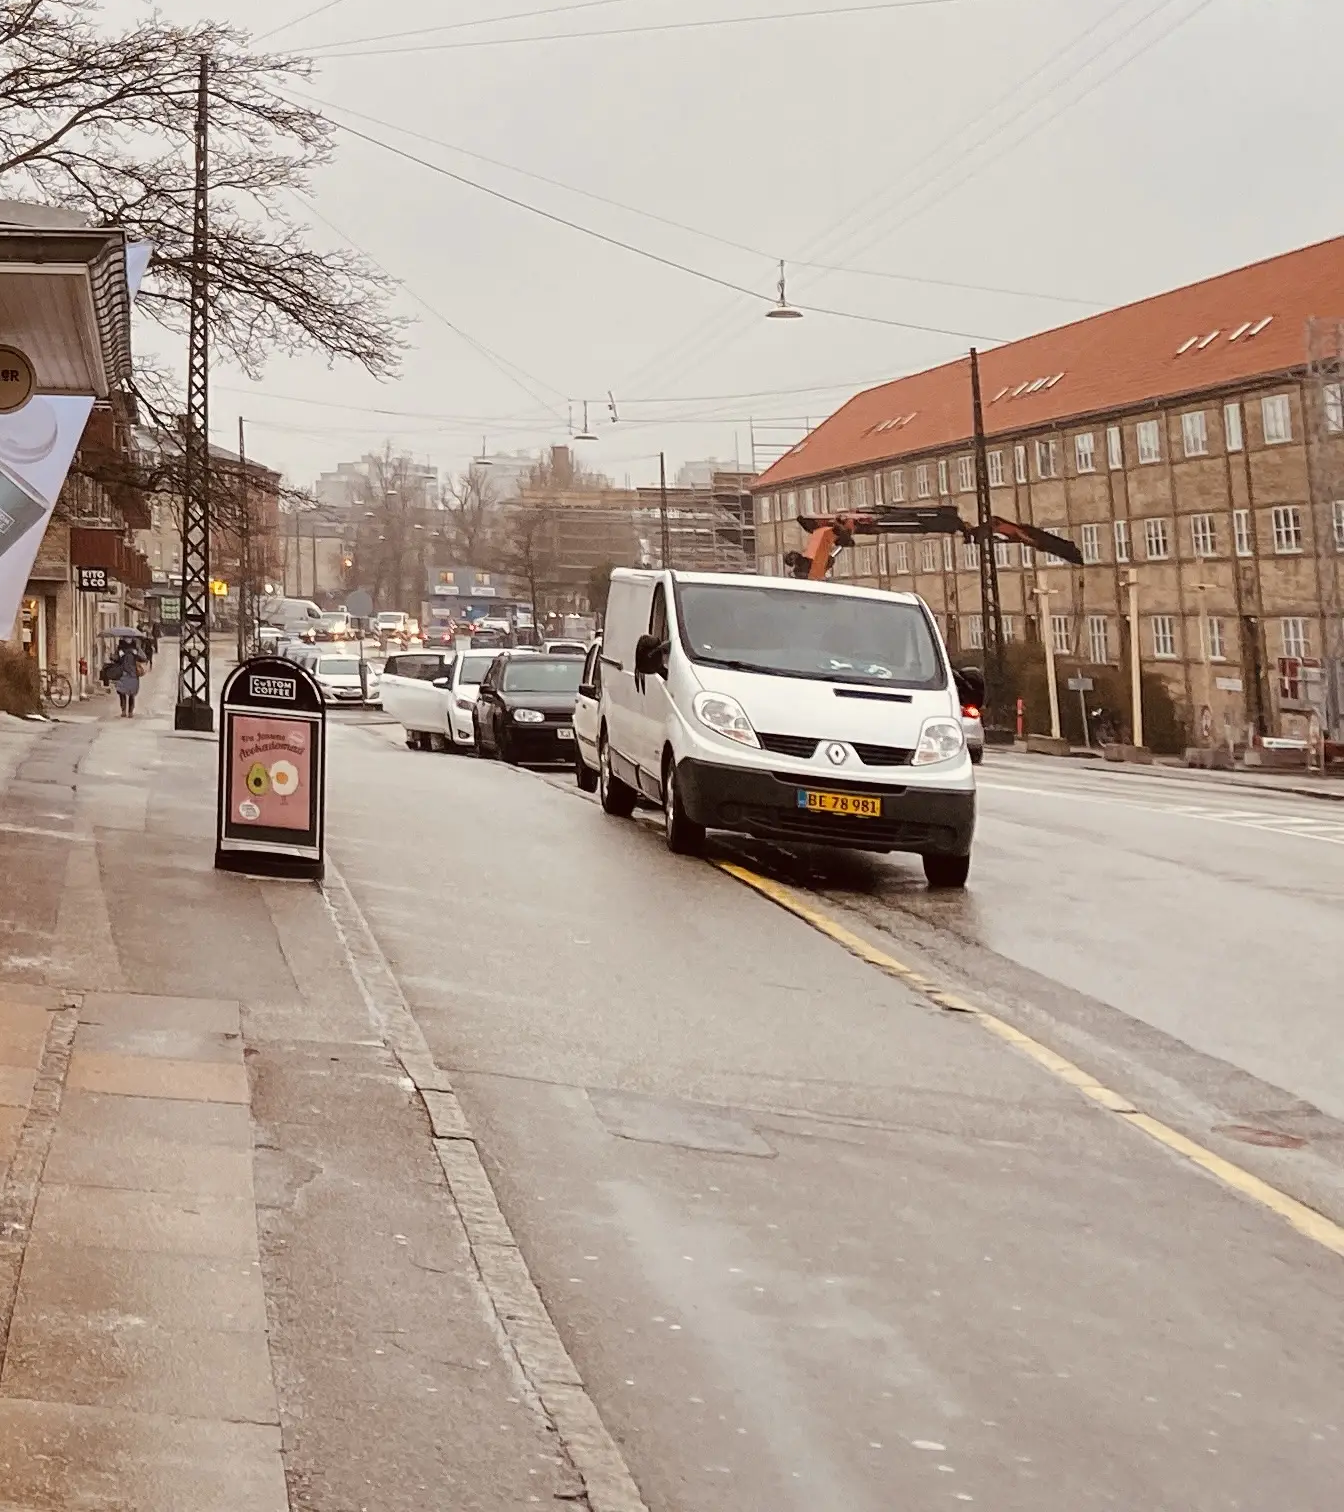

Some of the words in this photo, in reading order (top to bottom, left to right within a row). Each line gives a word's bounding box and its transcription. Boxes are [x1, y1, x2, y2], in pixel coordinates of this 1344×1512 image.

[82, 570, 105, 579] KITO
[83, 578, 89, 587] &
[90, 578, 105, 587] CO
[253, 678, 292, 689] CUSTOM
[254, 686, 290, 697] COFFEE
[808, 793, 827, 808] BE
[831, 796, 849, 811] 78
[852, 799, 877, 814] 981
